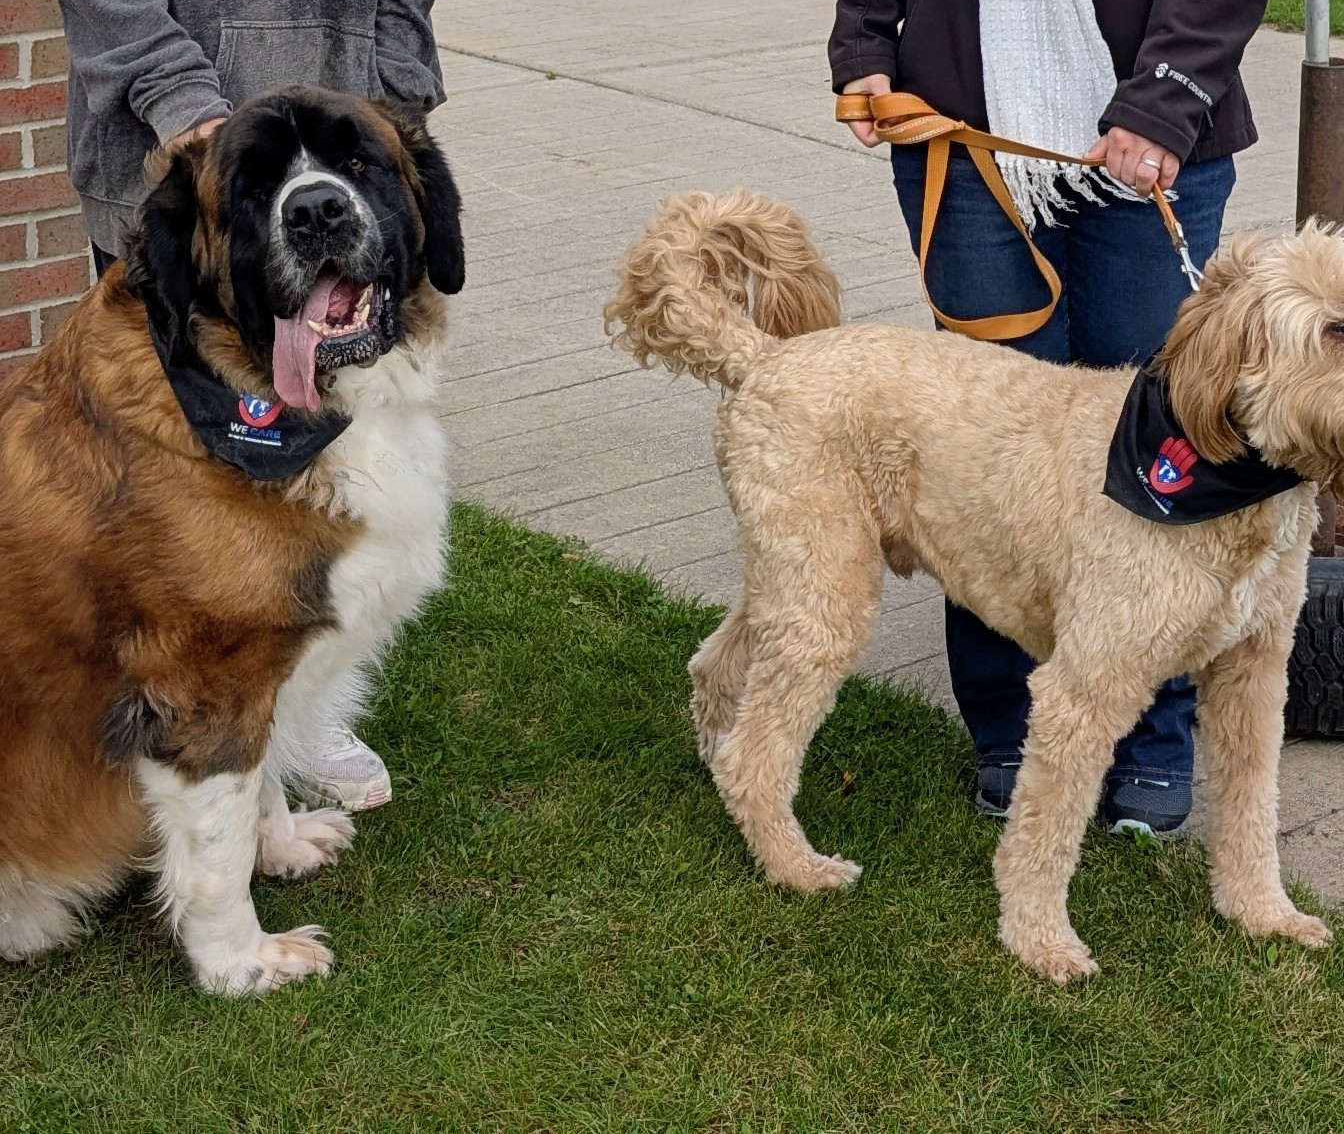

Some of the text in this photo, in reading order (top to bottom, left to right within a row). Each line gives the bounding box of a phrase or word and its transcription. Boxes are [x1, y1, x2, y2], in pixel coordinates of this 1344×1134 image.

[1168, 69, 1213, 106] FREE COUNTR
[230, 421, 249, 434] WE
[249, 427, 282, 440] CARE
